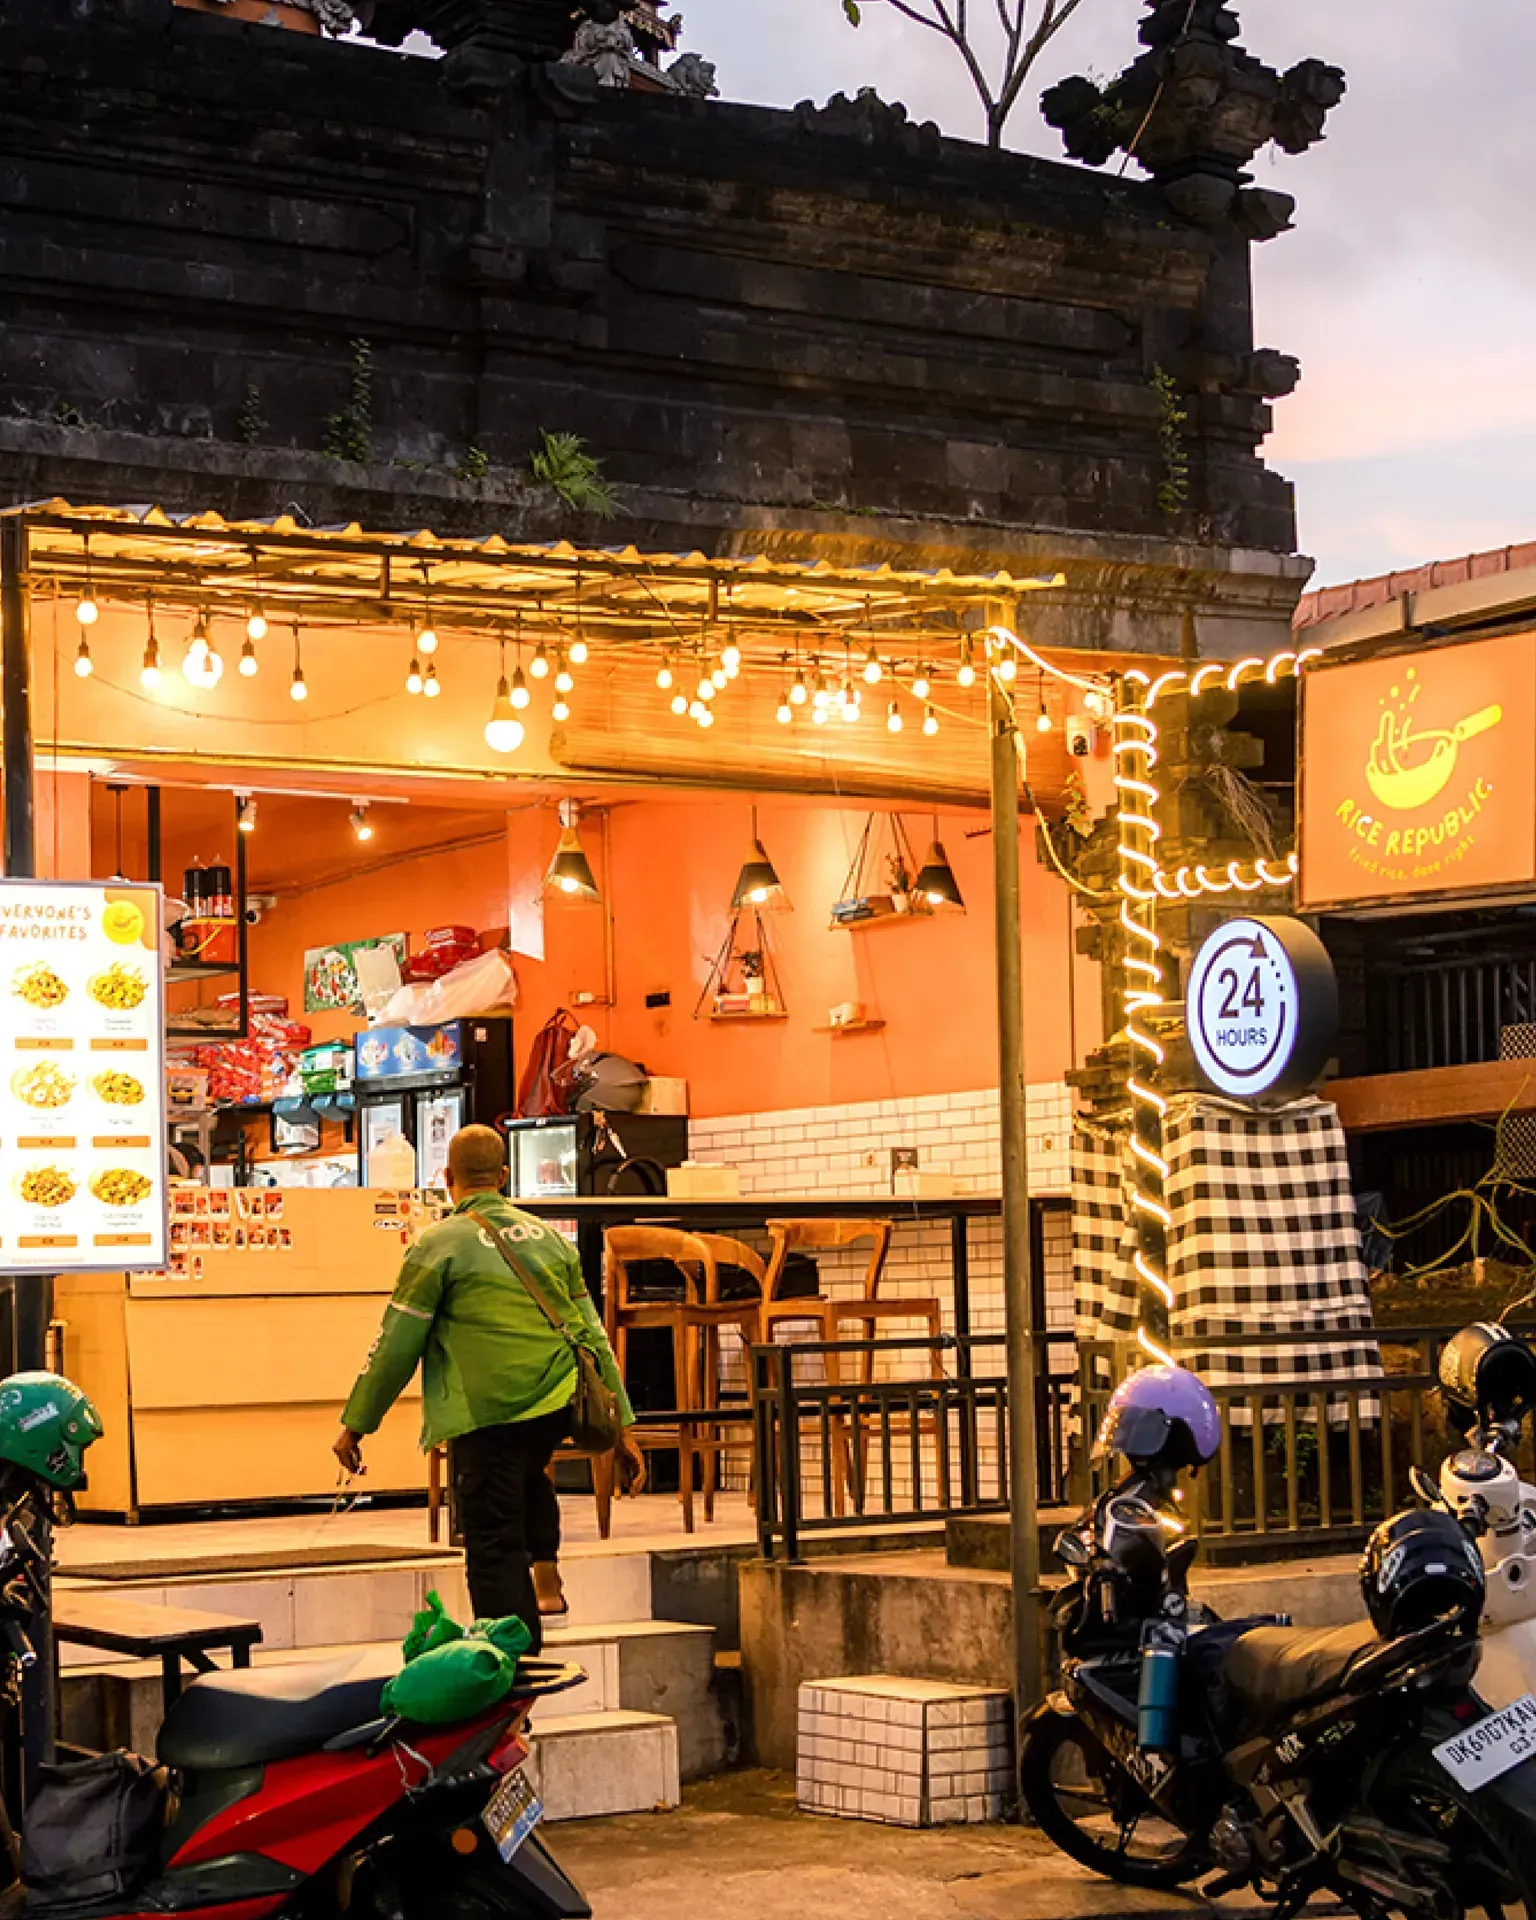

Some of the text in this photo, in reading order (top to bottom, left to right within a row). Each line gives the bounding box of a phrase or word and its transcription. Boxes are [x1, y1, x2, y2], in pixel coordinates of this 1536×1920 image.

[1335, 776, 1493, 857] RICE REPUBLIC
[0, 903, 92, 921] VERYONE'S
[1217, 965, 1266, 1020] 24
[1215, 1027, 1269, 1048] HOURS
